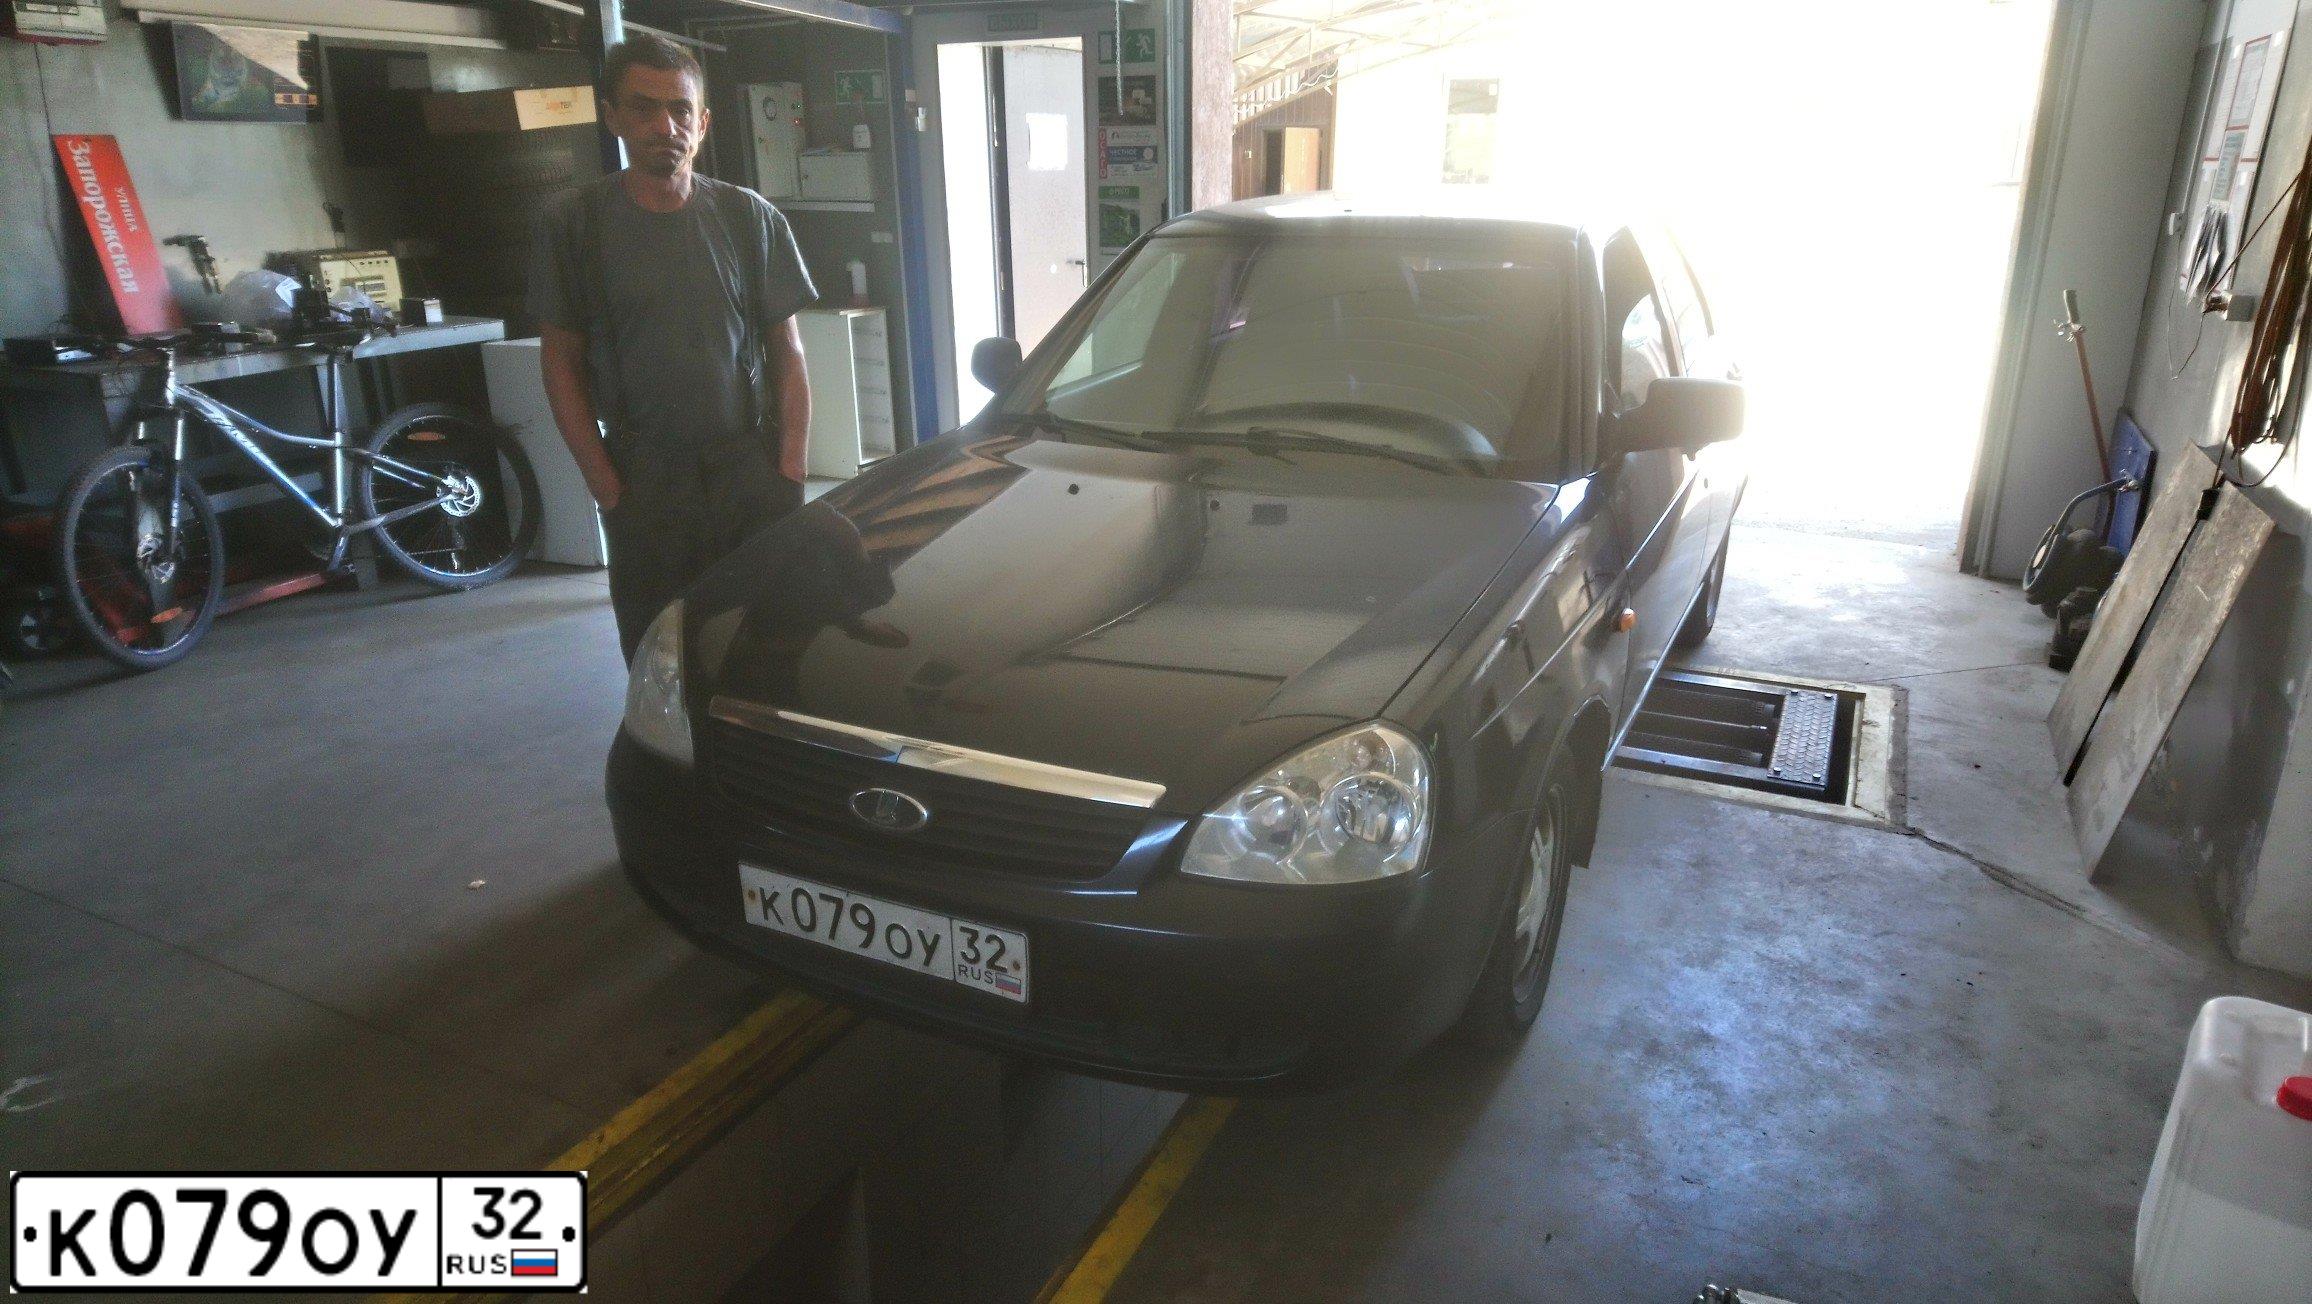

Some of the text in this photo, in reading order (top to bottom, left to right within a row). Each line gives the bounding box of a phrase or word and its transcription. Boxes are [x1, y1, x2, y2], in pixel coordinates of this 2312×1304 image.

[68, 140, 140, 293] Запорожская
[960, 926, 1008, 973] 32
[957, 964, 994, 985] RUS
